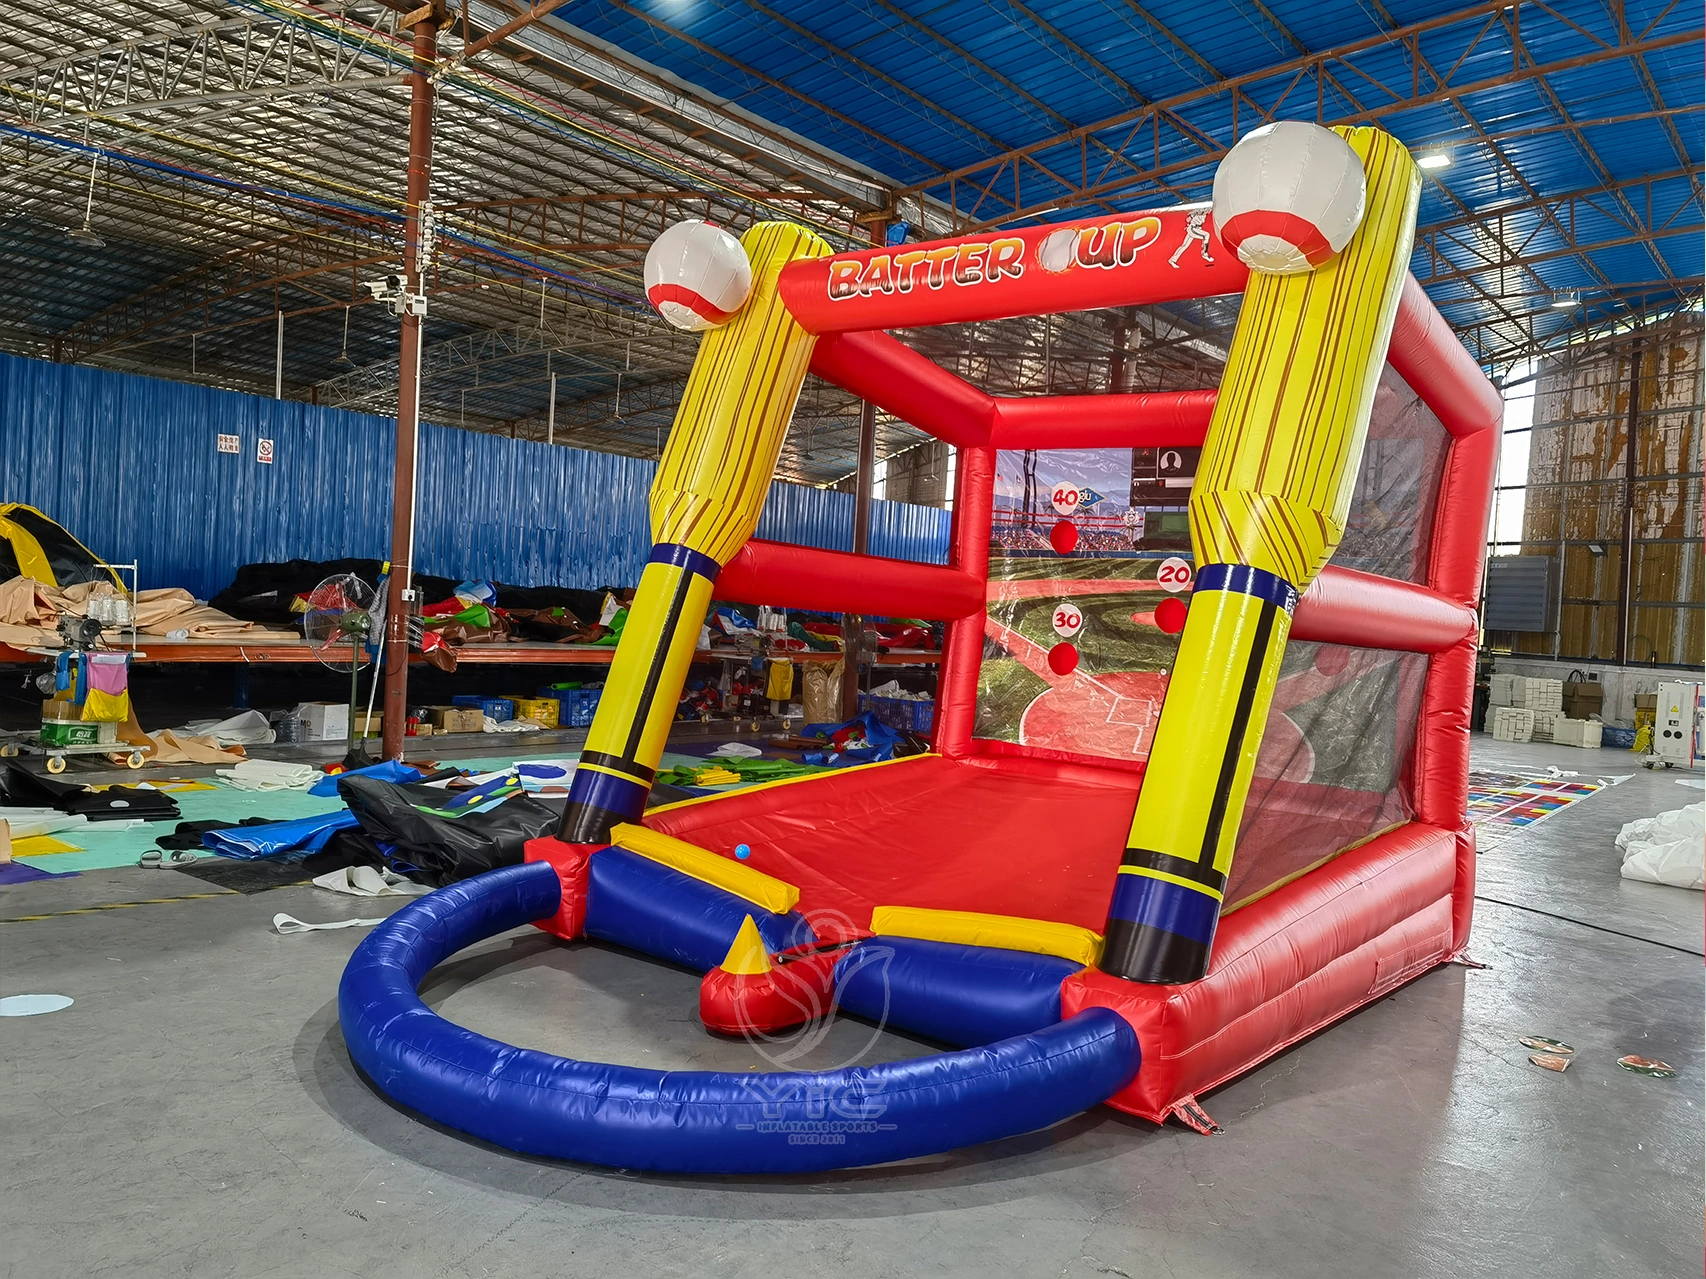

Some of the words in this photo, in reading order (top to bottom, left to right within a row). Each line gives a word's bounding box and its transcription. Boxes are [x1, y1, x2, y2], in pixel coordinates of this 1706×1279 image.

[828, 238, 1025, 301] BATTER
[1077, 216, 1161, 270] UP
[1052, 489, 1079, 506] 40
[1159, 565, 1190, 583] 20
[1054, 612, 1081, 629] 30
